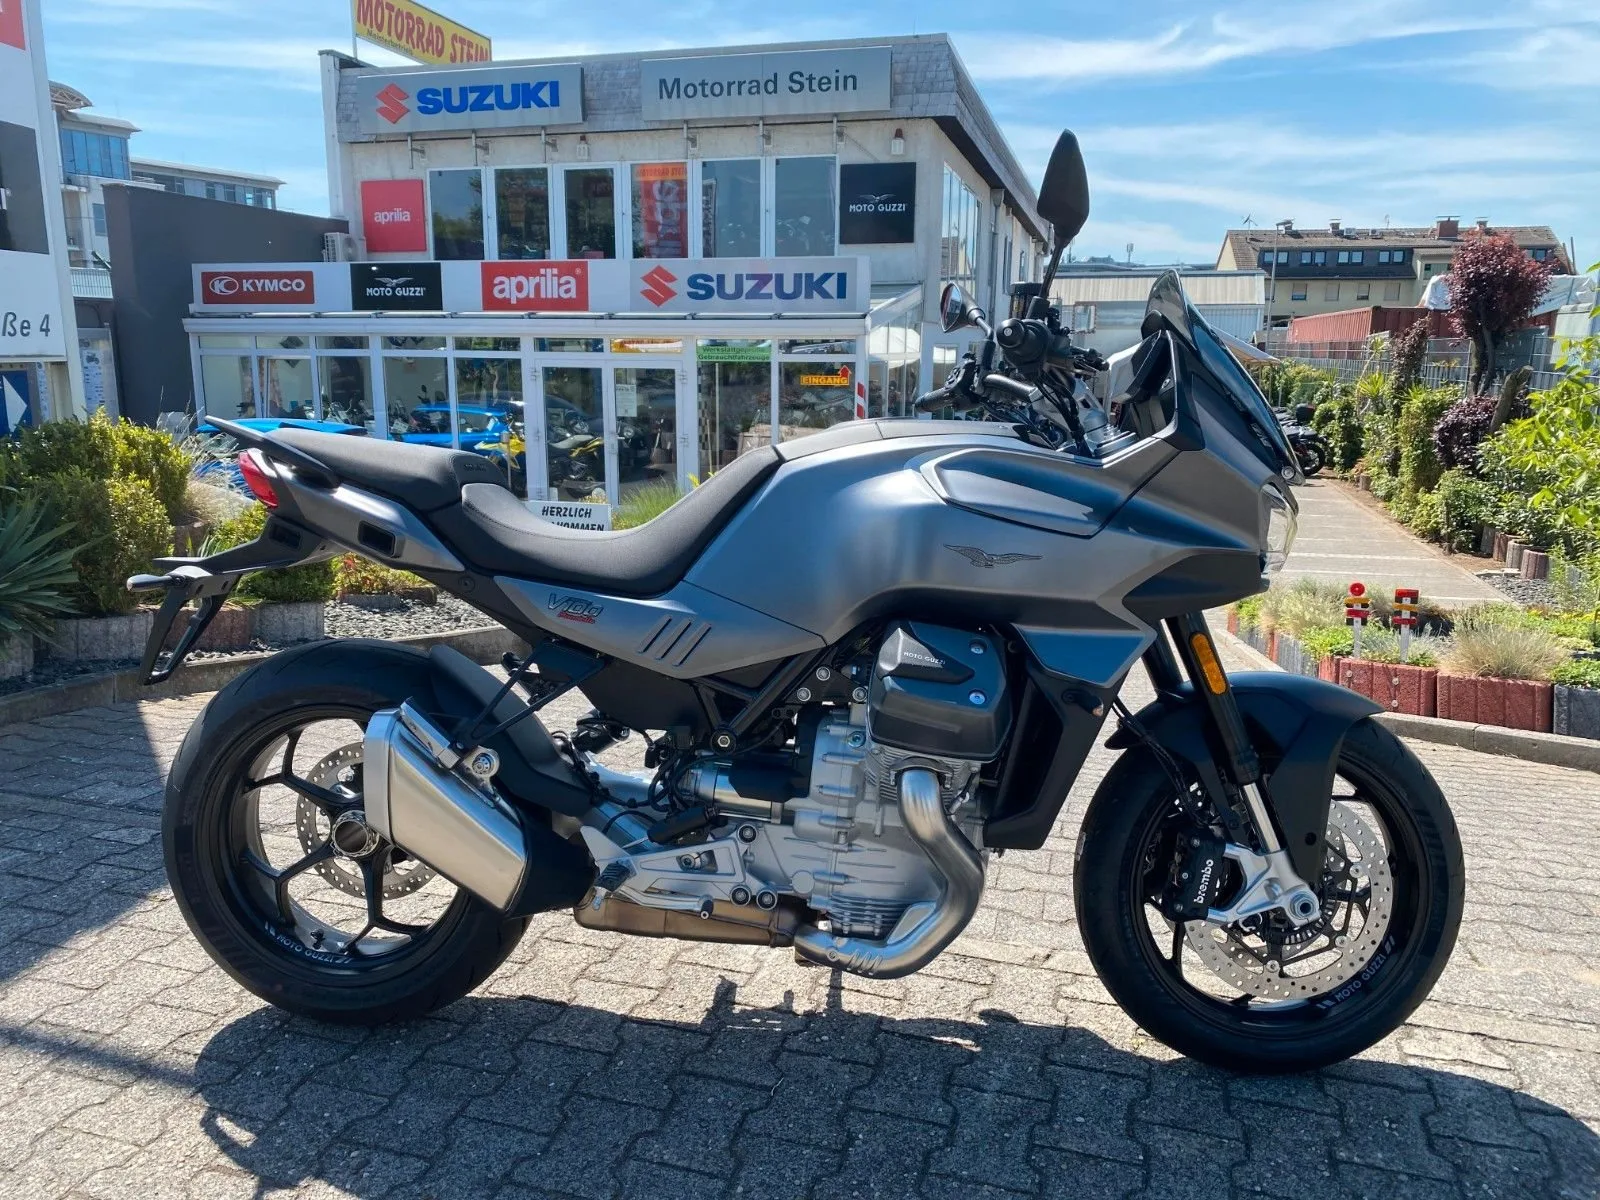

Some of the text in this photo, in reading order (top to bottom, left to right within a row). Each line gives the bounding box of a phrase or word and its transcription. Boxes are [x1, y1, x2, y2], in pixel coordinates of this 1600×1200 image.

[357, 0, 445, 58] MOTORRAD
[416, 80, 560, 115] SUZUKI
[658, 69, 858, 100] Motorrad Stein
[374, 207, 411, 225] aprilia
[849, 203, 906, 213] MOTO GUZZI
[242, 279, 306, 292] KYMCO
[366, 287, 424, 297] MOTO GUZZI
[493, 267, 577, 305] aprilia
[686, 271, 848, 301] SUZUKI
[39, 313, 51, 338] 4
[802, 376, 848, 385] EINGANG
[541, 505, 592, 519] HERZLICH
[903, 651, 946, 665] MOTO GUZZI
[1193, 859, 1214, 904] brembo
[276, 935, 334, 963] MOTO GUZZI
[1334, 953, 1387, 1002] MOTO GUZZI
